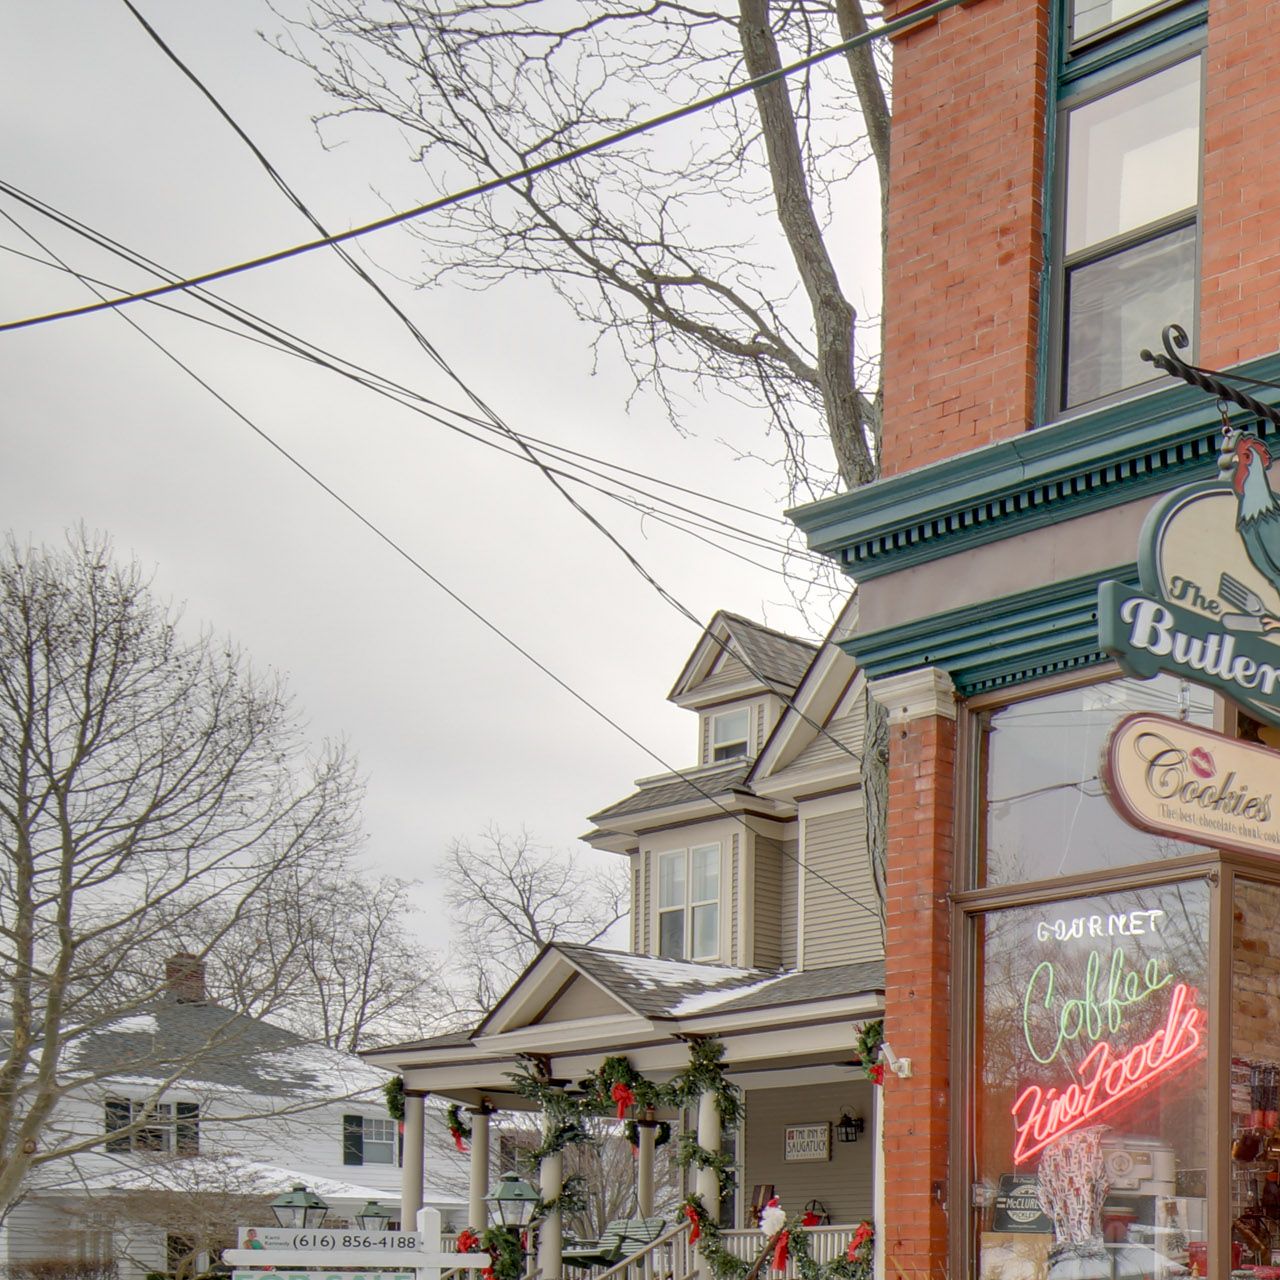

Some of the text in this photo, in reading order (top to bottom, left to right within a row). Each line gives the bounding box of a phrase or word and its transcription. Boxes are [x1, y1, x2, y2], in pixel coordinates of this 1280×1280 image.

[1170, 575, 1222, 614] The
[1134, 732, 1272, 822] Cookies
[1024, 947, 1174, 1064] Coffee
[1011, 984, 1200, 1160] Fine Foods
[293, 1234, 416, 1249] (616) 856-4188
